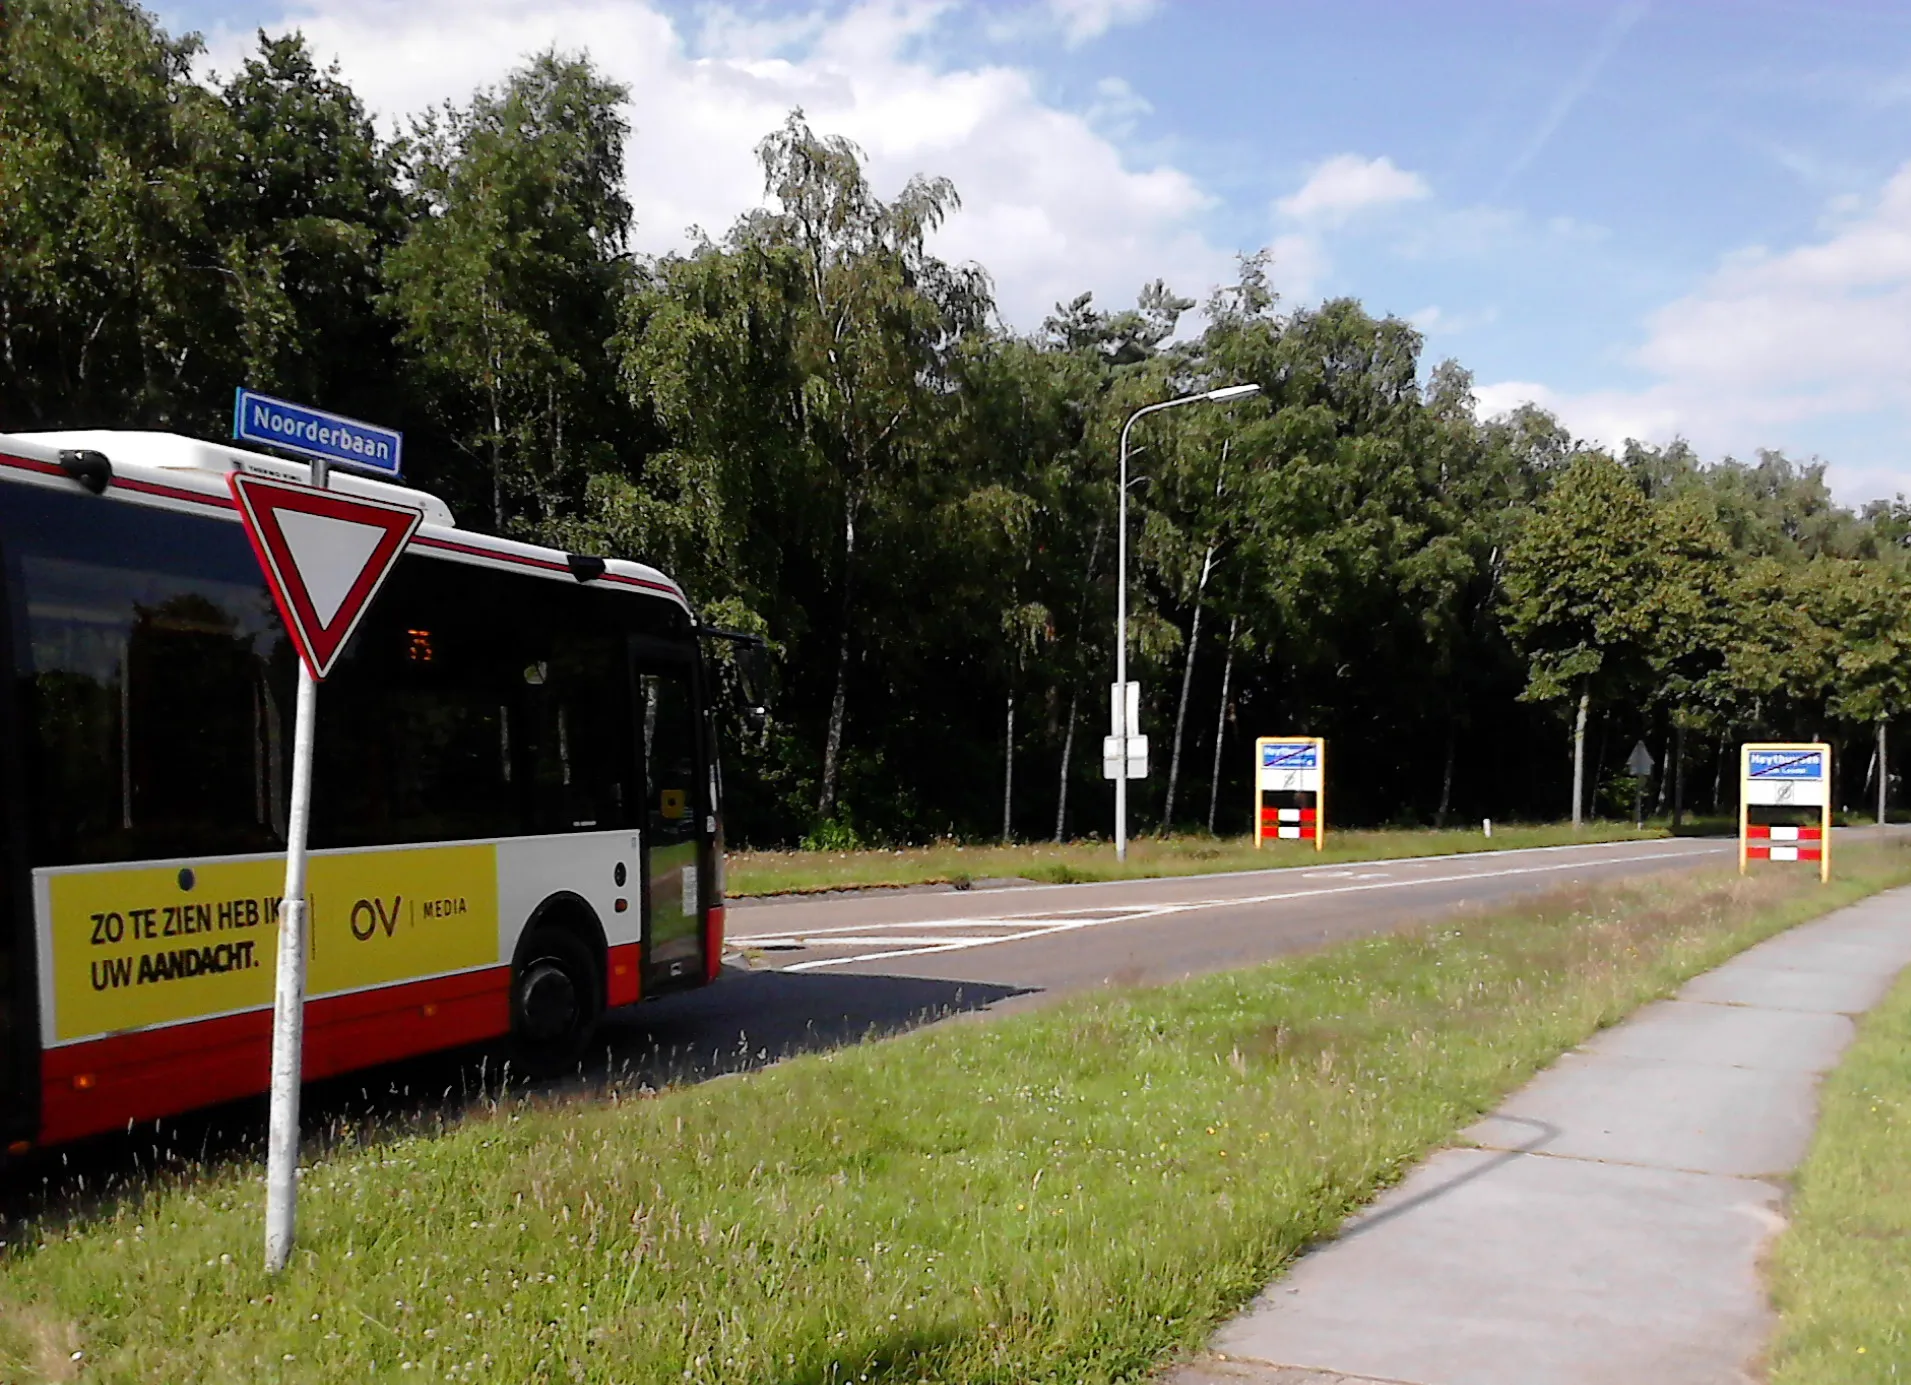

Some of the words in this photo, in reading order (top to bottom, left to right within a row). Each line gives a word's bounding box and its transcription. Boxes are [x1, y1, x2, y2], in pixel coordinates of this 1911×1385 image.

[253, 404, 389, 460] Noorderbaan
[90, 912, 124, 945] ZO
[129, 907, 158, 940] TE
[163, 903, 211, 937] ZIEN
[218, 899, 260, 931] HEB
[264, 896, 283, 925] IK
[350, 895, 402, 941] OV
[422, 897, 467, 921] MEDIA
[91, 957, 133, 991] UW
[137, 941, 260, 985] AANDACHT.
